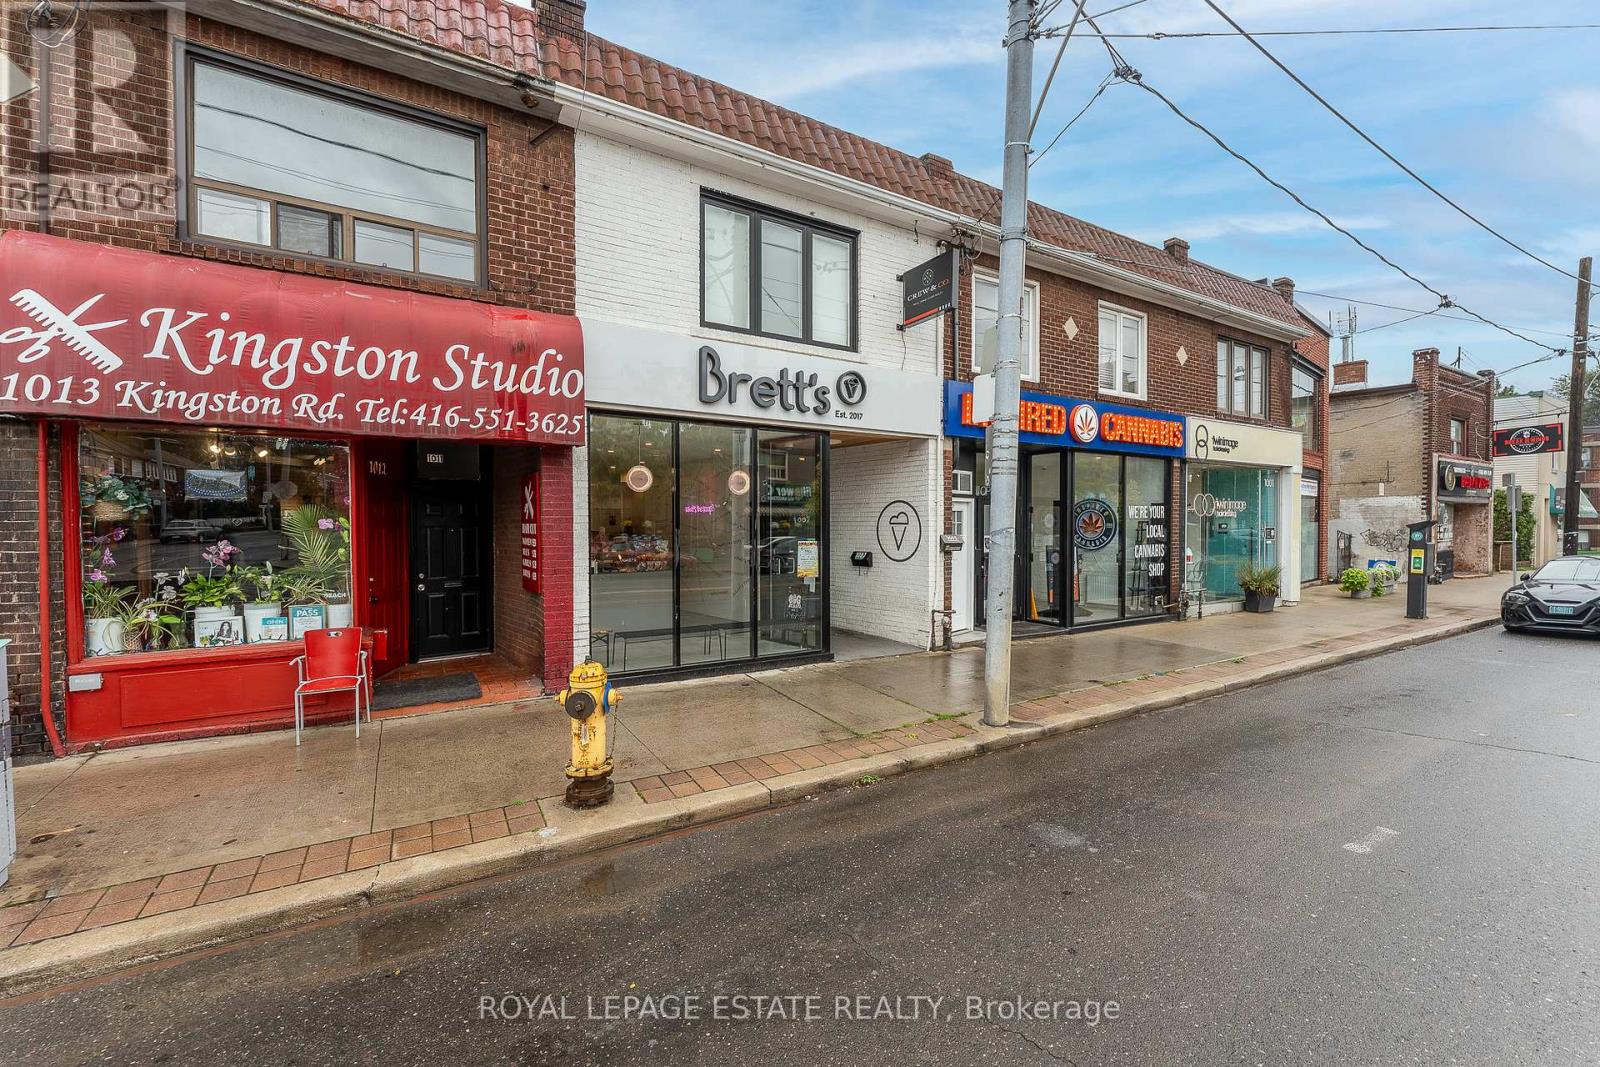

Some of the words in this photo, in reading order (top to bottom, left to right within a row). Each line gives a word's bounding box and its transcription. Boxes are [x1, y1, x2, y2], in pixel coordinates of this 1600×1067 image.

[907, 287, 930, 302] CREW
[140, 306, 420, 390] Kingston
[433, 343, 583, 400] Studio
[698, 345, 831, 415] Brett's
[1, 372, 101, 404] 1013
[115, 379, 282, 421] Kingston
[292, 393, 344, 422] Rd.
[834, 410, 847, 419] Est.
[849, 411, 864, 421] 2017
[1100, 412, 1184, 448] CANNABIS
[1128, 505, 1148, 519] WE'RE
[1148, 505, 1165, 519] YOUR
[1146, 525, 1165, 538] LOCAL
[1134, 544, 1165, 558] CANNABIS
[1148, 563, 1165, 577] SHOP
[296, 608, 319, 617] PASS
